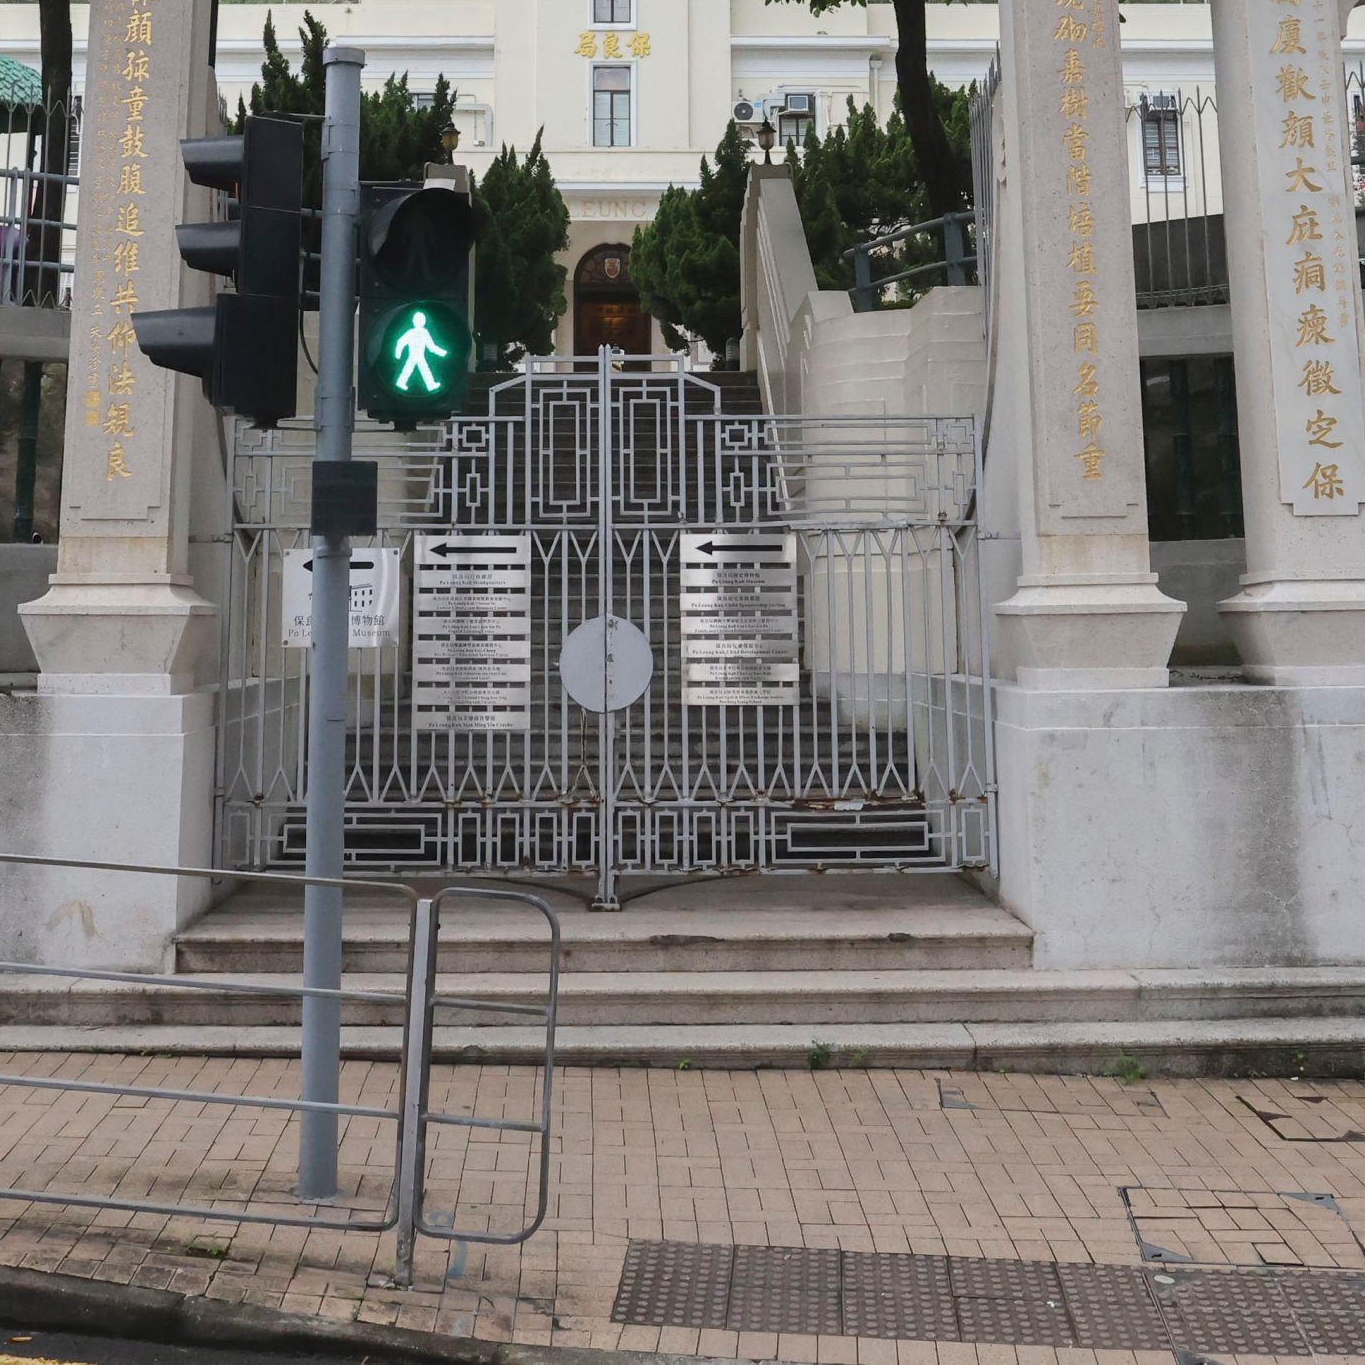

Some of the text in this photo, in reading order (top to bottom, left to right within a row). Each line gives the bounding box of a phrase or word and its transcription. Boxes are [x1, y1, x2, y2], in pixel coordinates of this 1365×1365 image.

[575, 32, 651, 59] 保良局
[288, 628, 299, 637] Po
[352, 628, 391, 637] Museum
